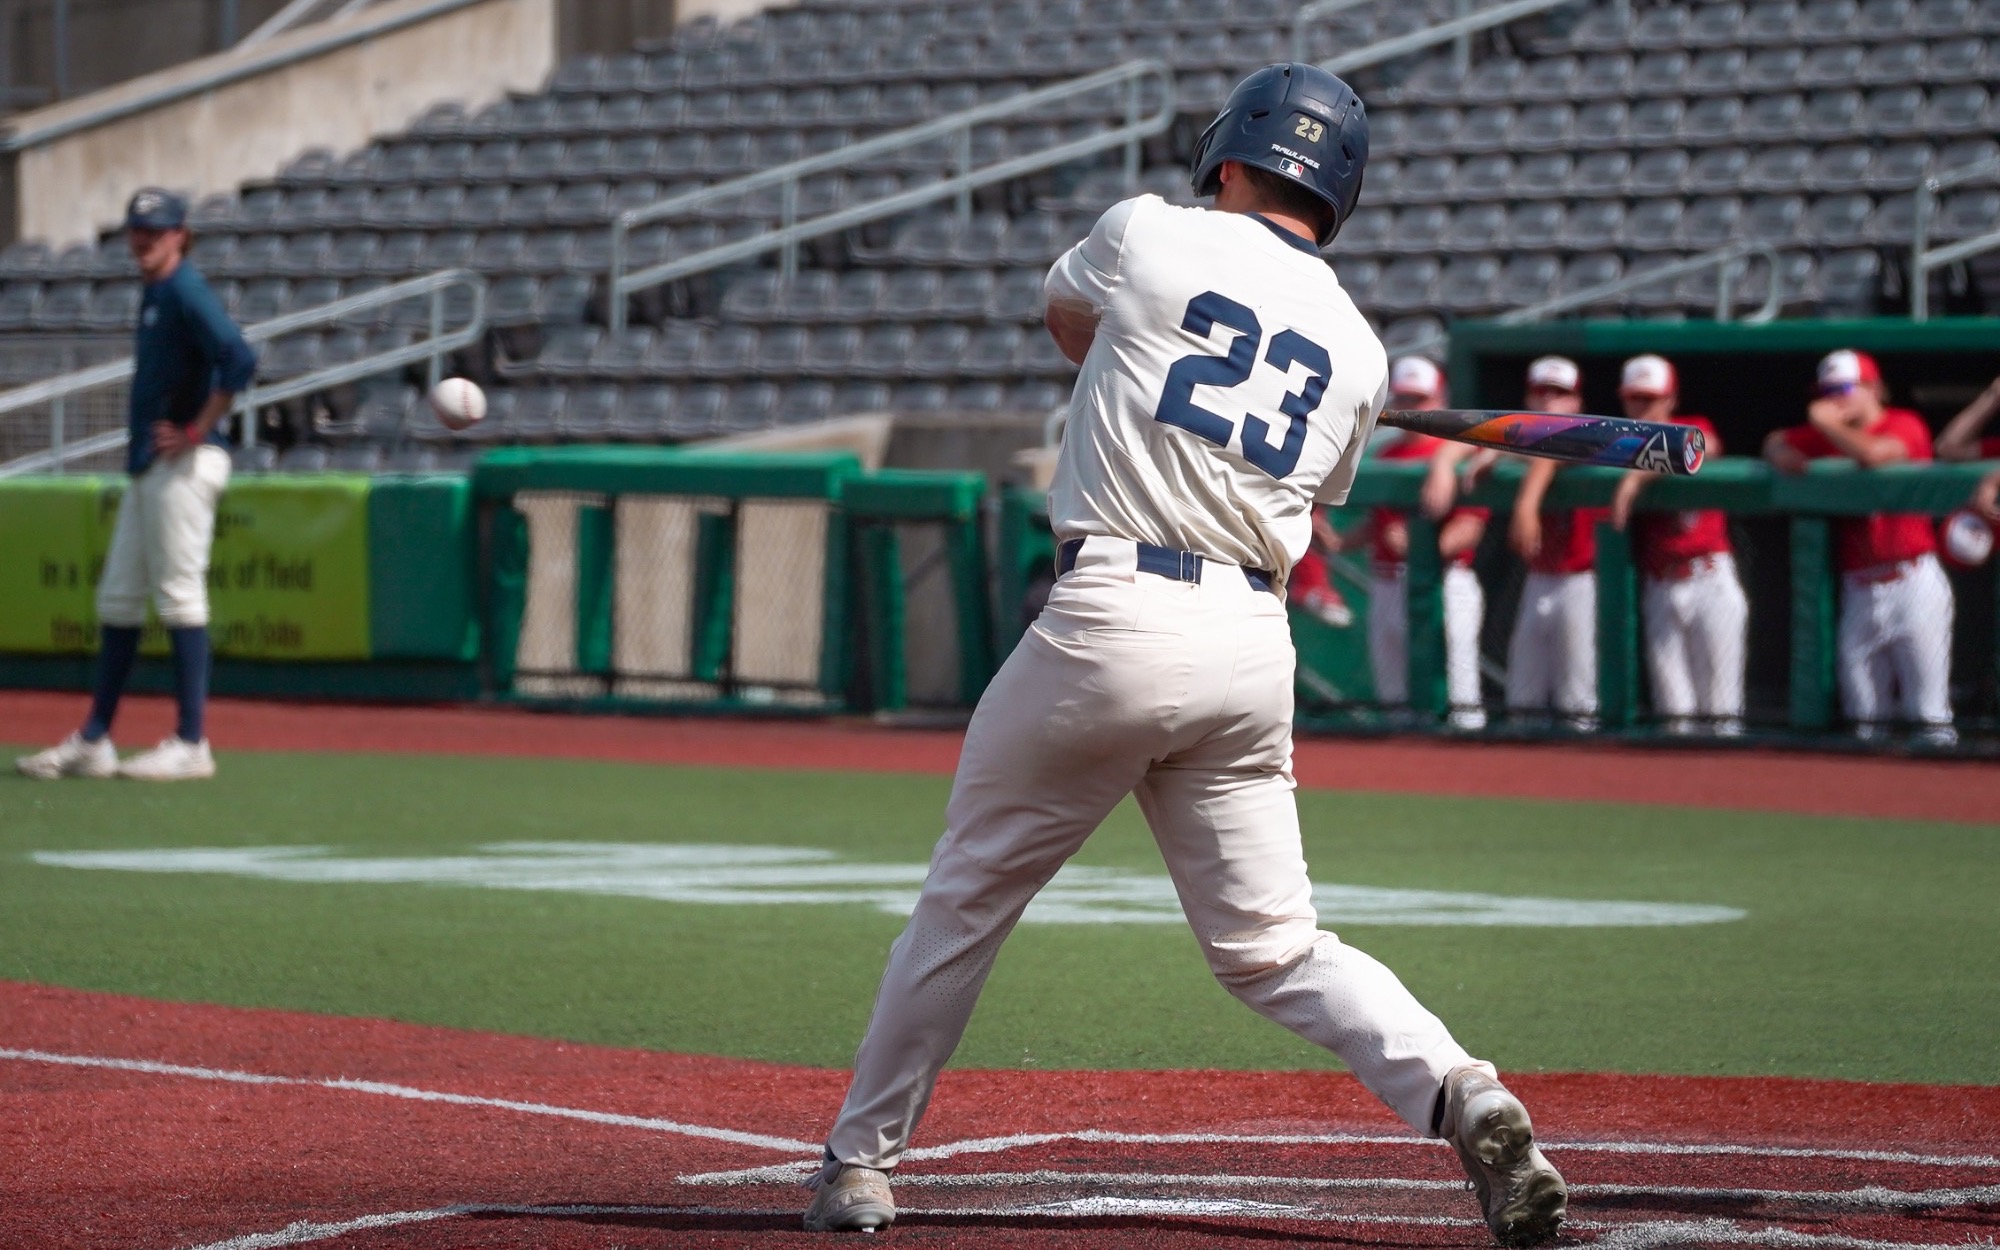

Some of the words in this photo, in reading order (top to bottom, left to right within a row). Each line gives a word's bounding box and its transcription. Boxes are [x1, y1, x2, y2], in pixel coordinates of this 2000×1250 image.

[1294, 117, 1323, 143] 23
[1271, 143, 1321, 170] RAWLINGS
[1154, 290, 1333, 481] 23
